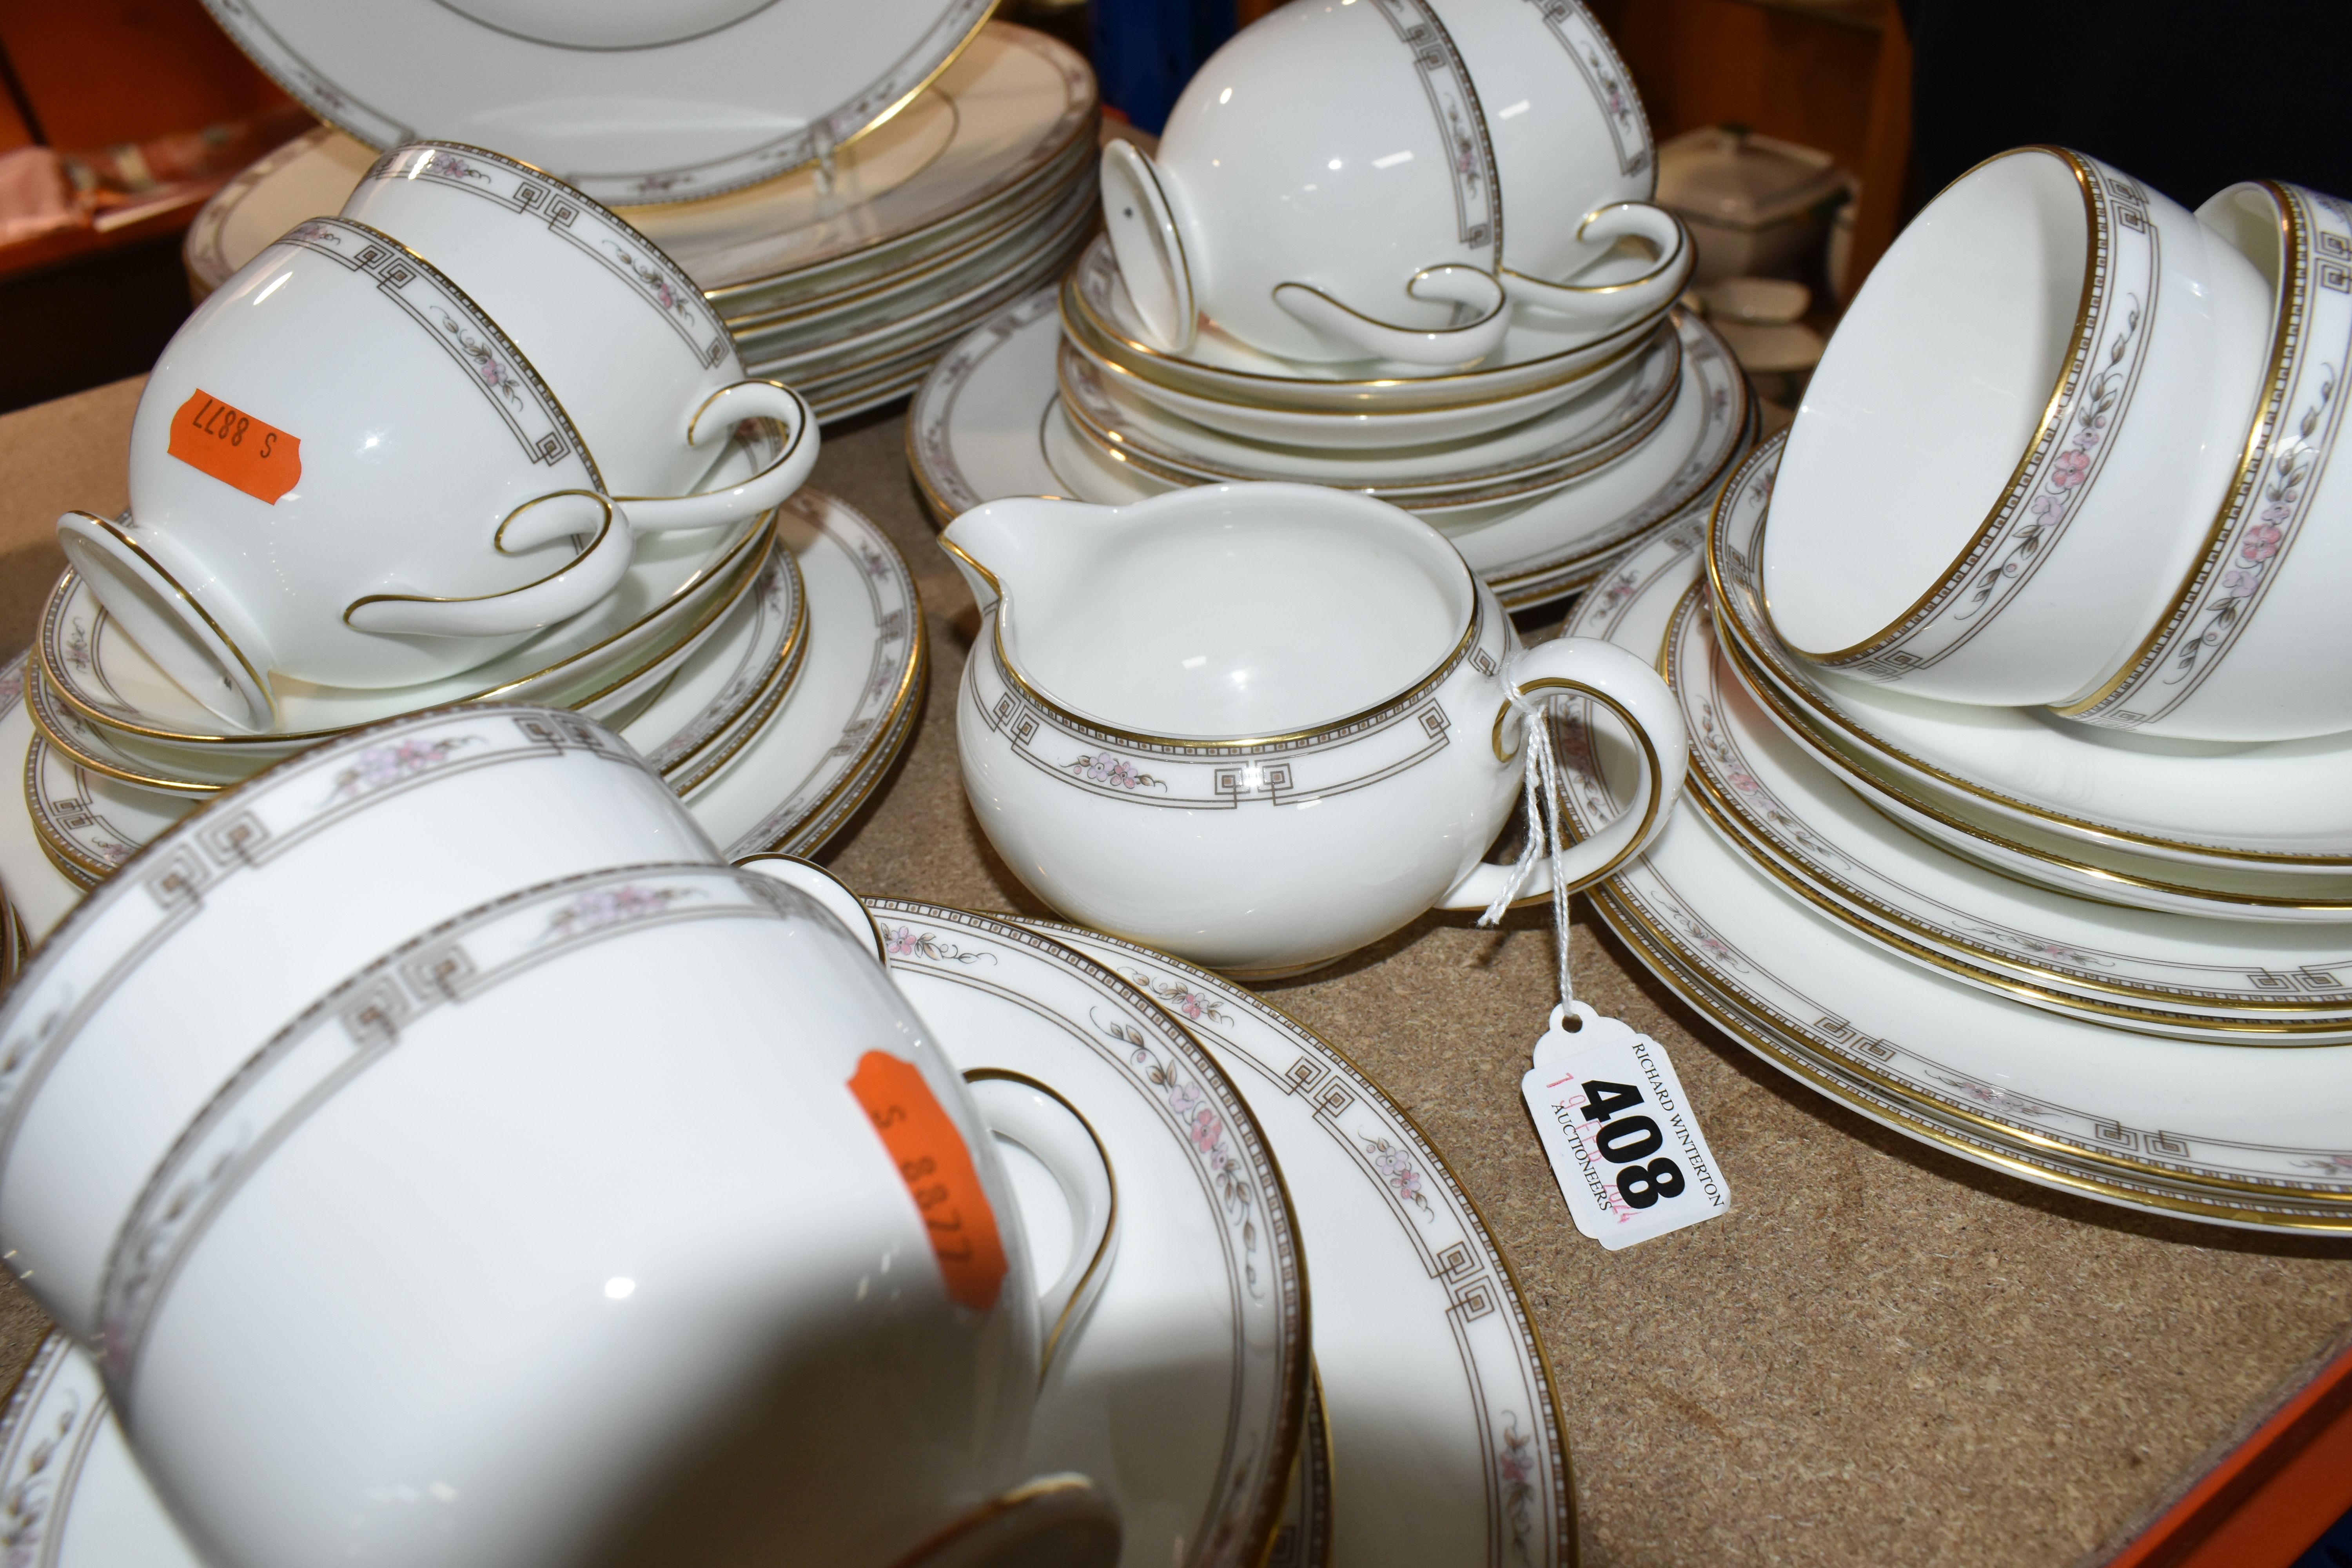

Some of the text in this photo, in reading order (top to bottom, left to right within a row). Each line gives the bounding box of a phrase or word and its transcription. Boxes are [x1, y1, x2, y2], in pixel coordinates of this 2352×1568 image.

[192, 399, 277, 458] S 8877
[871, 1105, 973, 1263] S 8877
[1551, 1104, 1613, 1211] AUCTIONEERS
[1580, 1080, 1685, 1209] 408
[1632, 1042, 1724, 1207] RICHARD WINTERTON
